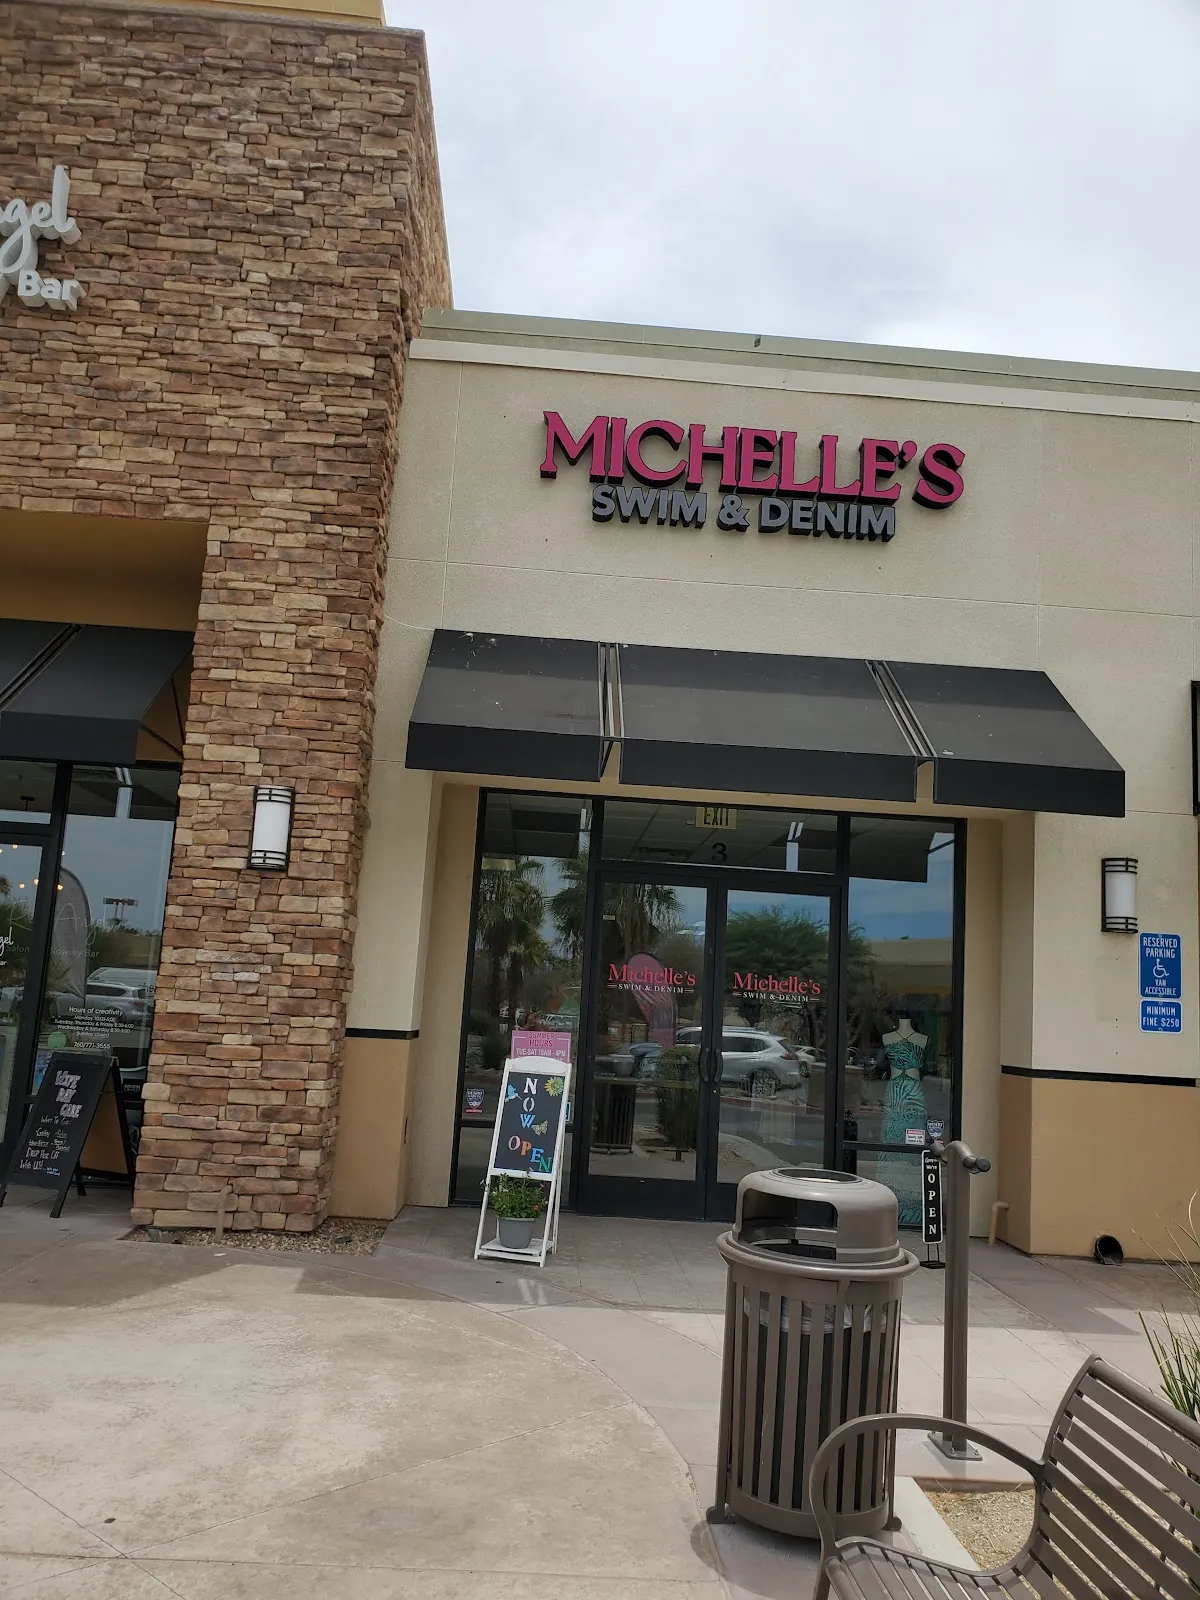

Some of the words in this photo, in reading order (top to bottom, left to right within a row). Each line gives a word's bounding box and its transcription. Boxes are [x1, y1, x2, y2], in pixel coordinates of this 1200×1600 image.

[0, 165, 82, 302] gel
[18, 270, 86, 311] Bar
[540, 411, 966, 510] MICHELLE'S
[592, 484, 707, 529] SWIM
[717, 494, 750, 532] &
[759, 497, 896, 542] DENIM
[703, 806, 729, 826] EXIT
[712, 842, 727, 863] 3
[1143, 936, 1178, 948] RESERVED
[1145, 948, 1176, 959] PARKING
[608, 963, 696, 986] Michelle's
[733, 972, 821, 994] Michelle's
[1155, 979, 1167, 987] VAN
[743, 991, 766, 999] SWIM
[779, 994, 809, 1002] DENIM
[1145, 986, 1177, 996] ACCESSIBLE
[68, 1006, 86, 1014] Hours
[1146, 1006, 1176, 1016] MINIMUM
[1142, 1017, 1158, 1027] FINE
[1160, 1018, 1179, 1028] $250
[529, 1032, 555, 1040] SUMMER
[516, 1047, 537, 1055] TUE-SAT
[520, 1077, 538, 1128] NOW
[508, 1135, 553, 1172] OPEN
[927, 1173, 937, 1235] OPEN
